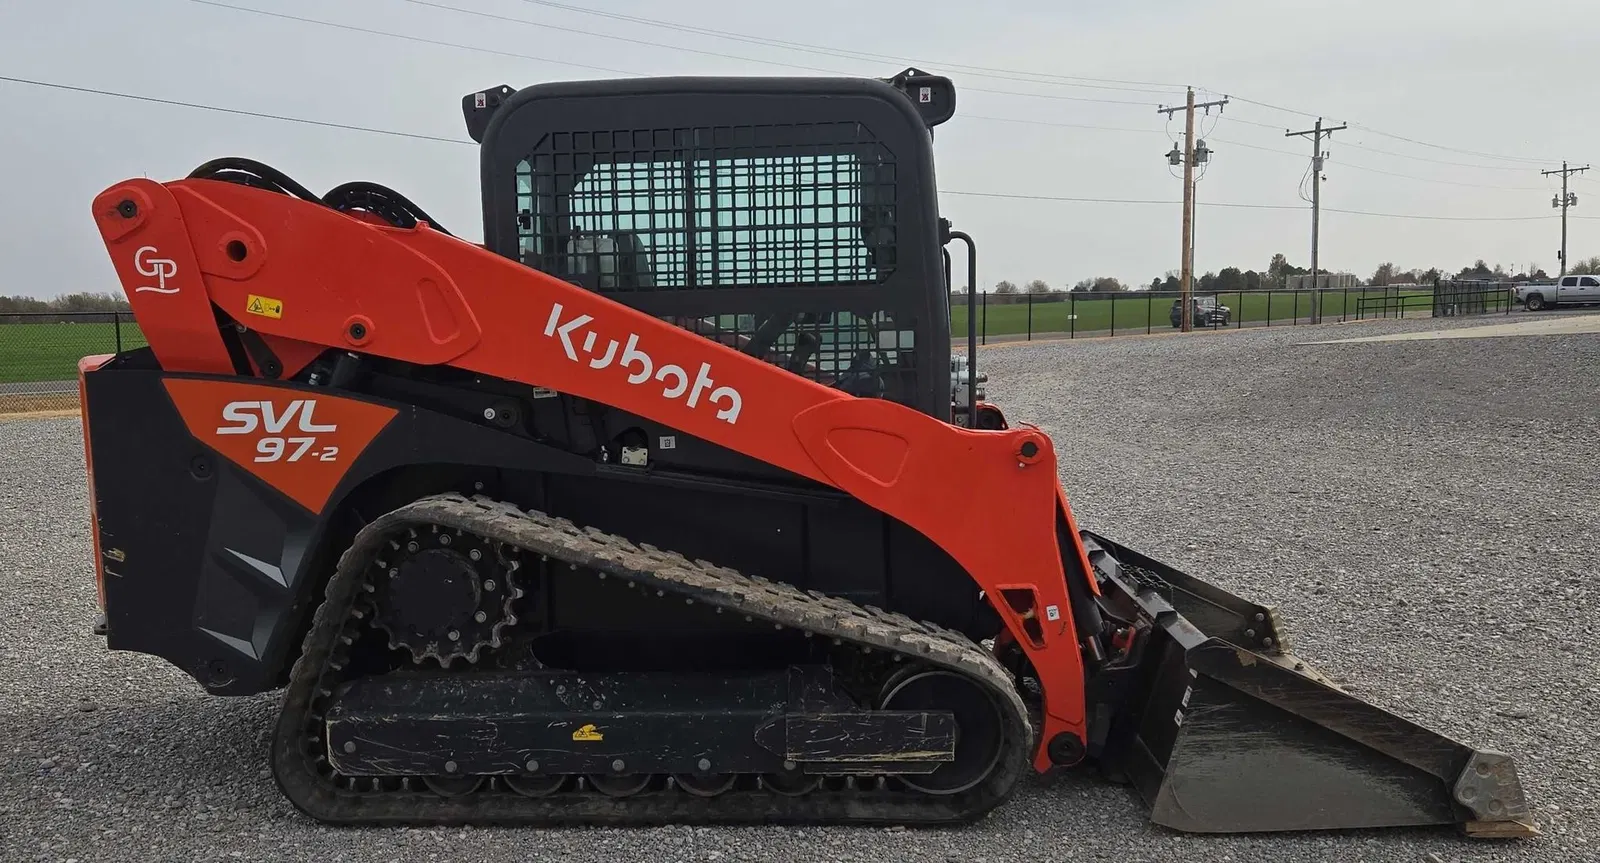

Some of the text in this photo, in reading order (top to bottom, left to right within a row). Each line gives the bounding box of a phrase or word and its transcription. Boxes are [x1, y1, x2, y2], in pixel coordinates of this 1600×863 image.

[543, 303, 743, 425] Kubota
[216, 400, 337, 434] SVL
[254, 437, 339, 462] 97-2
